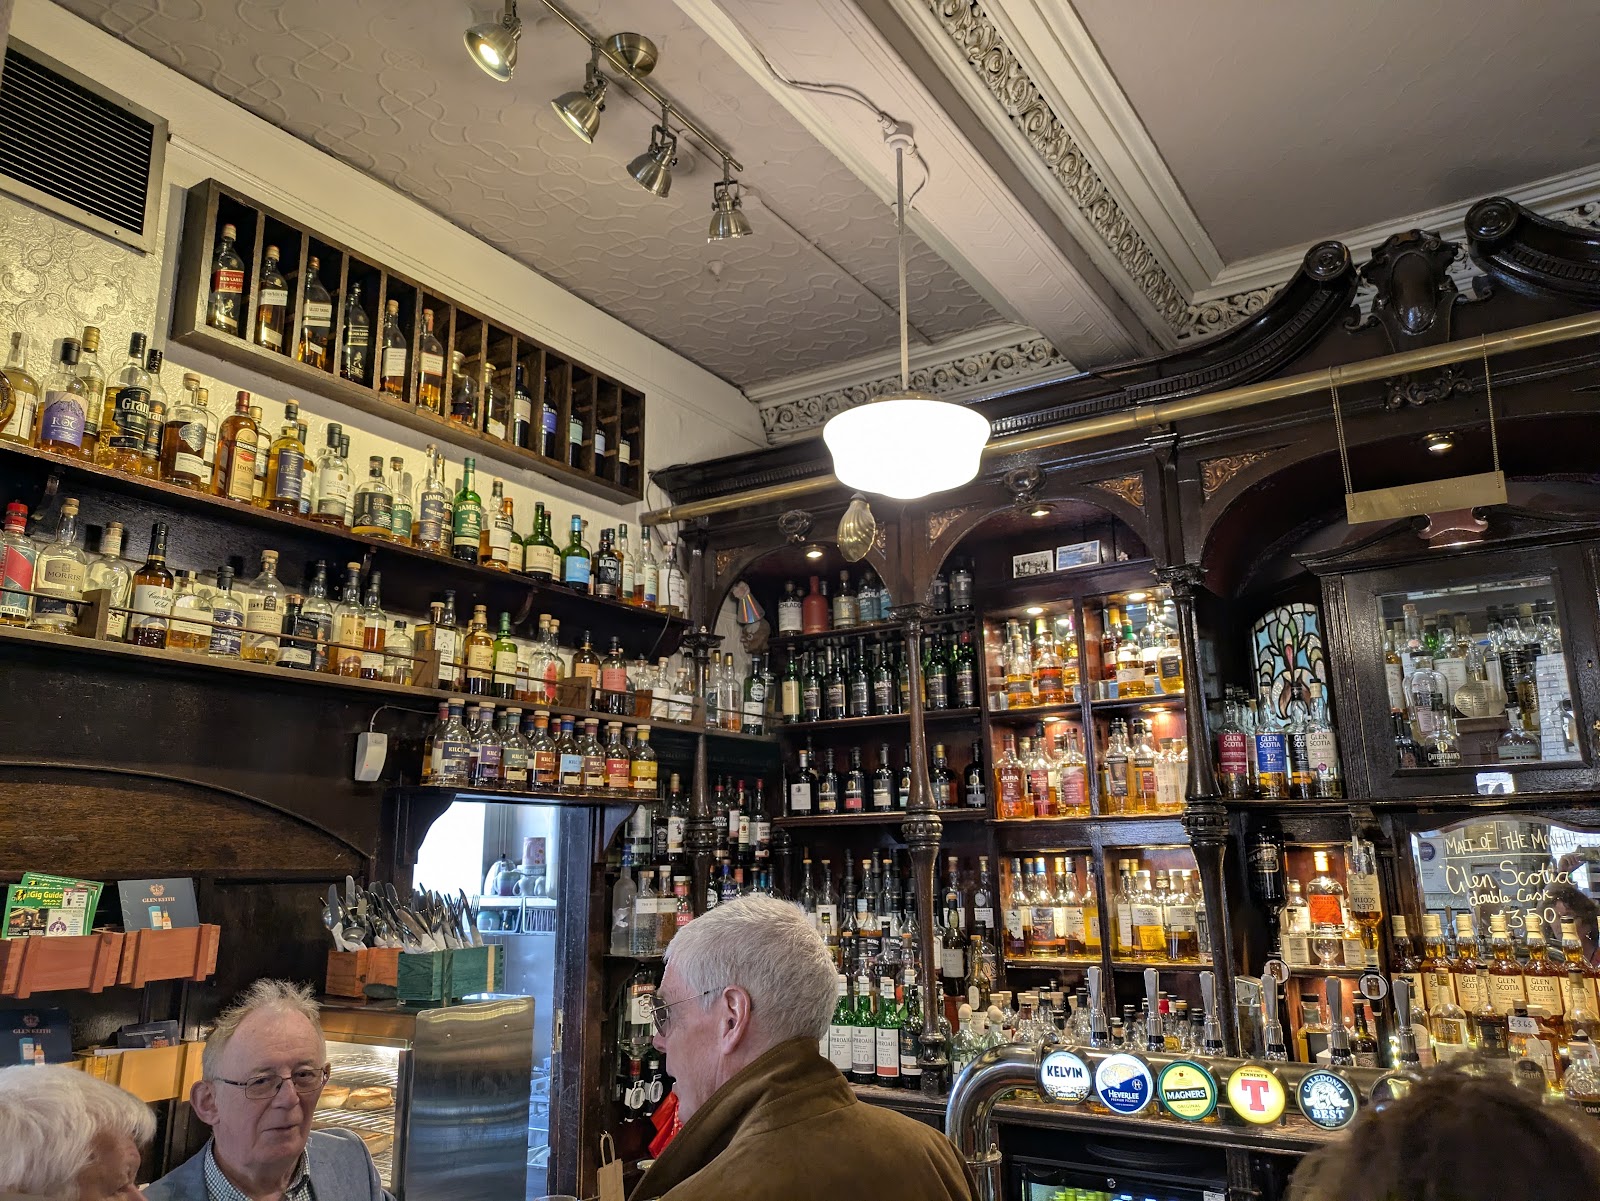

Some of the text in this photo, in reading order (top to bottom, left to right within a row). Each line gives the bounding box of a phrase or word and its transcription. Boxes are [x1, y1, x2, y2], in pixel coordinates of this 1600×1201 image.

[47, 571, 82, 581] MORRIS
[1310, 733, 1328, 741] GLEN
[1309, 740, 1331, 748] SCOTIA
[1266, 753, 1276, 762] 12
[1445, 837, 1475, 855] MALT
[1480, 832, 1494, 851] OF
[1501, 830, 1529, 851] THE
[1445, 860, 1578, 895] Glen Scotia
[30, 890, 64, 899] Gig Guide
[1469, 890, 1512, 907] double
[1497, 977, 1516, 985] GLEN
[1530, 977, 1550, 985] GLEN
[1495, 983, 1520, 991] SCOTIA
[1530, 984, 1555, 992] SCOTIA
[1047, 1065, 1083, 1079] KELVIN
[1304, 1074, 1345, 1094] CALEDONIA
[1108, 1089, 1140, 1100] HEVERLEE
[1166, 1087, 1206, 1101] MAGNERS
[1241, 1079, 1269, 1112] T
[1312, 1108, 1345, 1120] BEST
